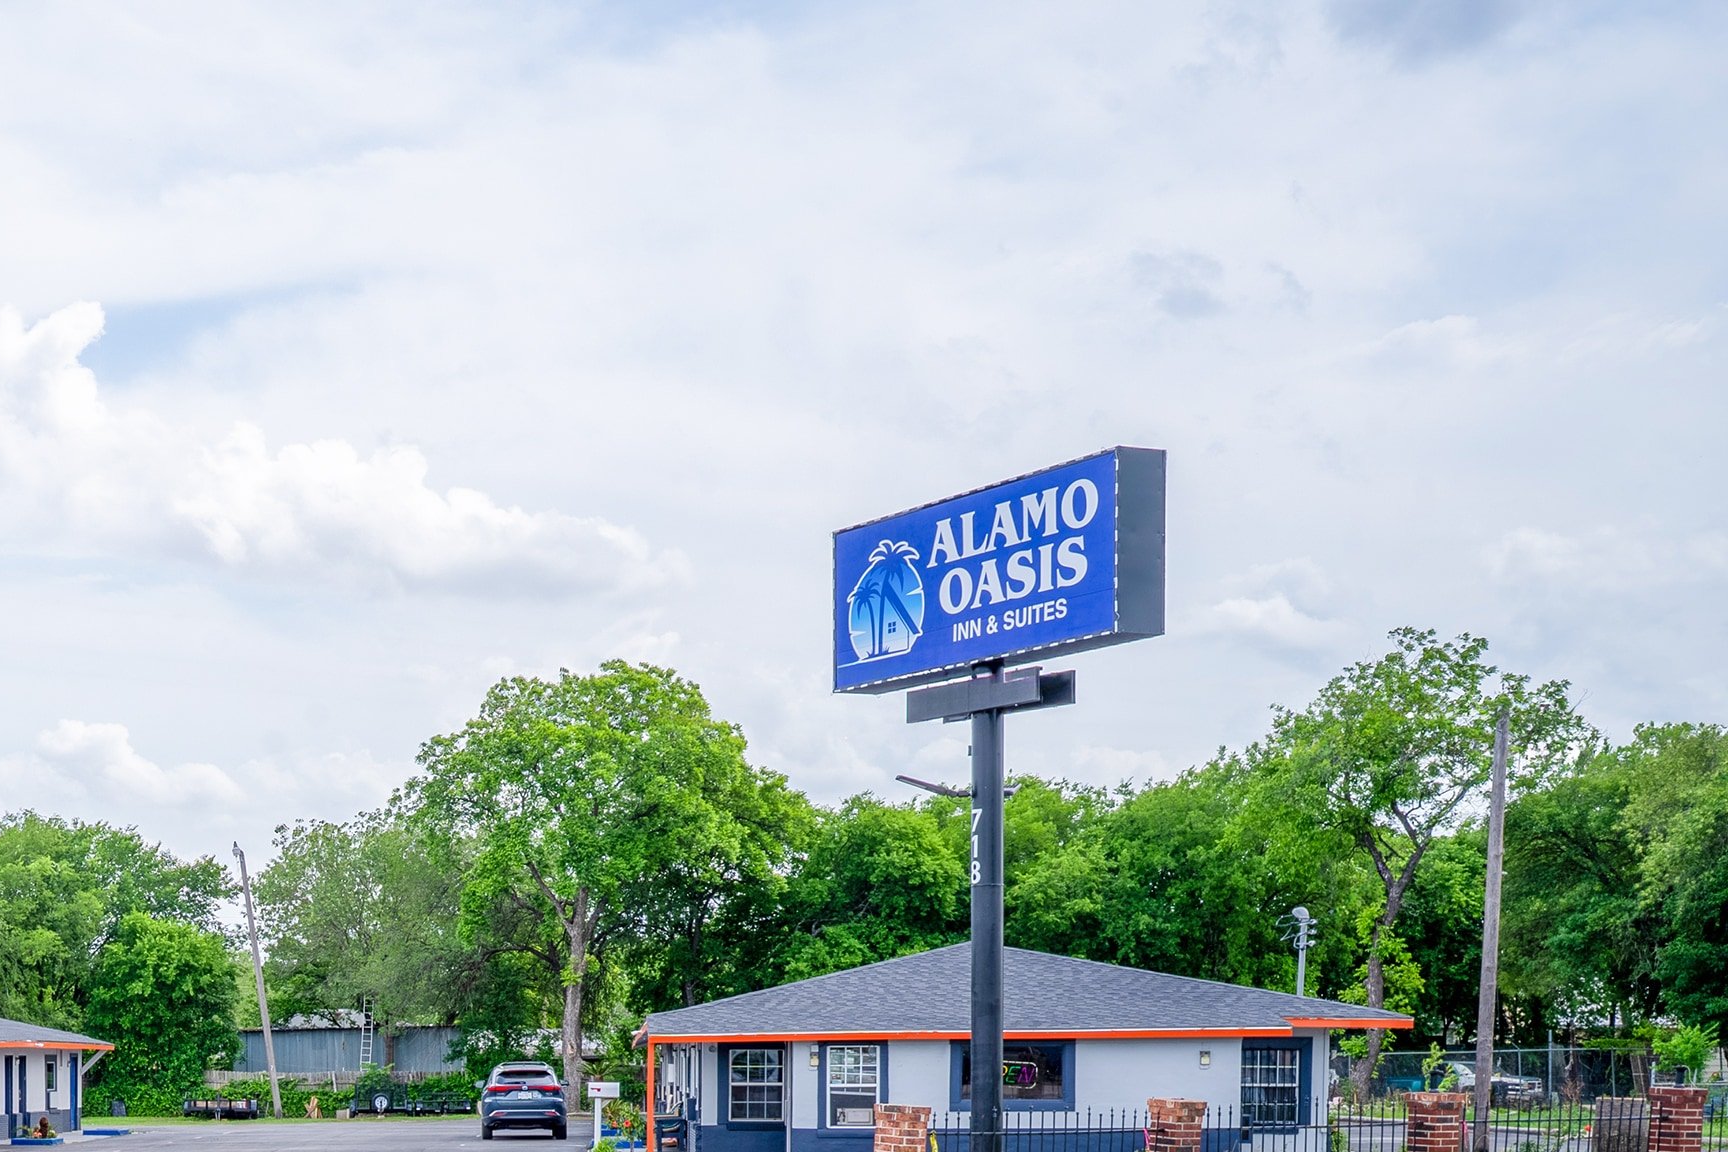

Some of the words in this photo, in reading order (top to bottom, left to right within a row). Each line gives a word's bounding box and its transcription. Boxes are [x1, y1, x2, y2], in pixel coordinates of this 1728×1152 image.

[927, 478, 1099, 569] ALAMO
[939, 536, 1089, 615] OASIS
[952, 619, 981, 642] INN
[986, 617, 998, 634] &
[1003, 598, 1068, 631] SUITES
